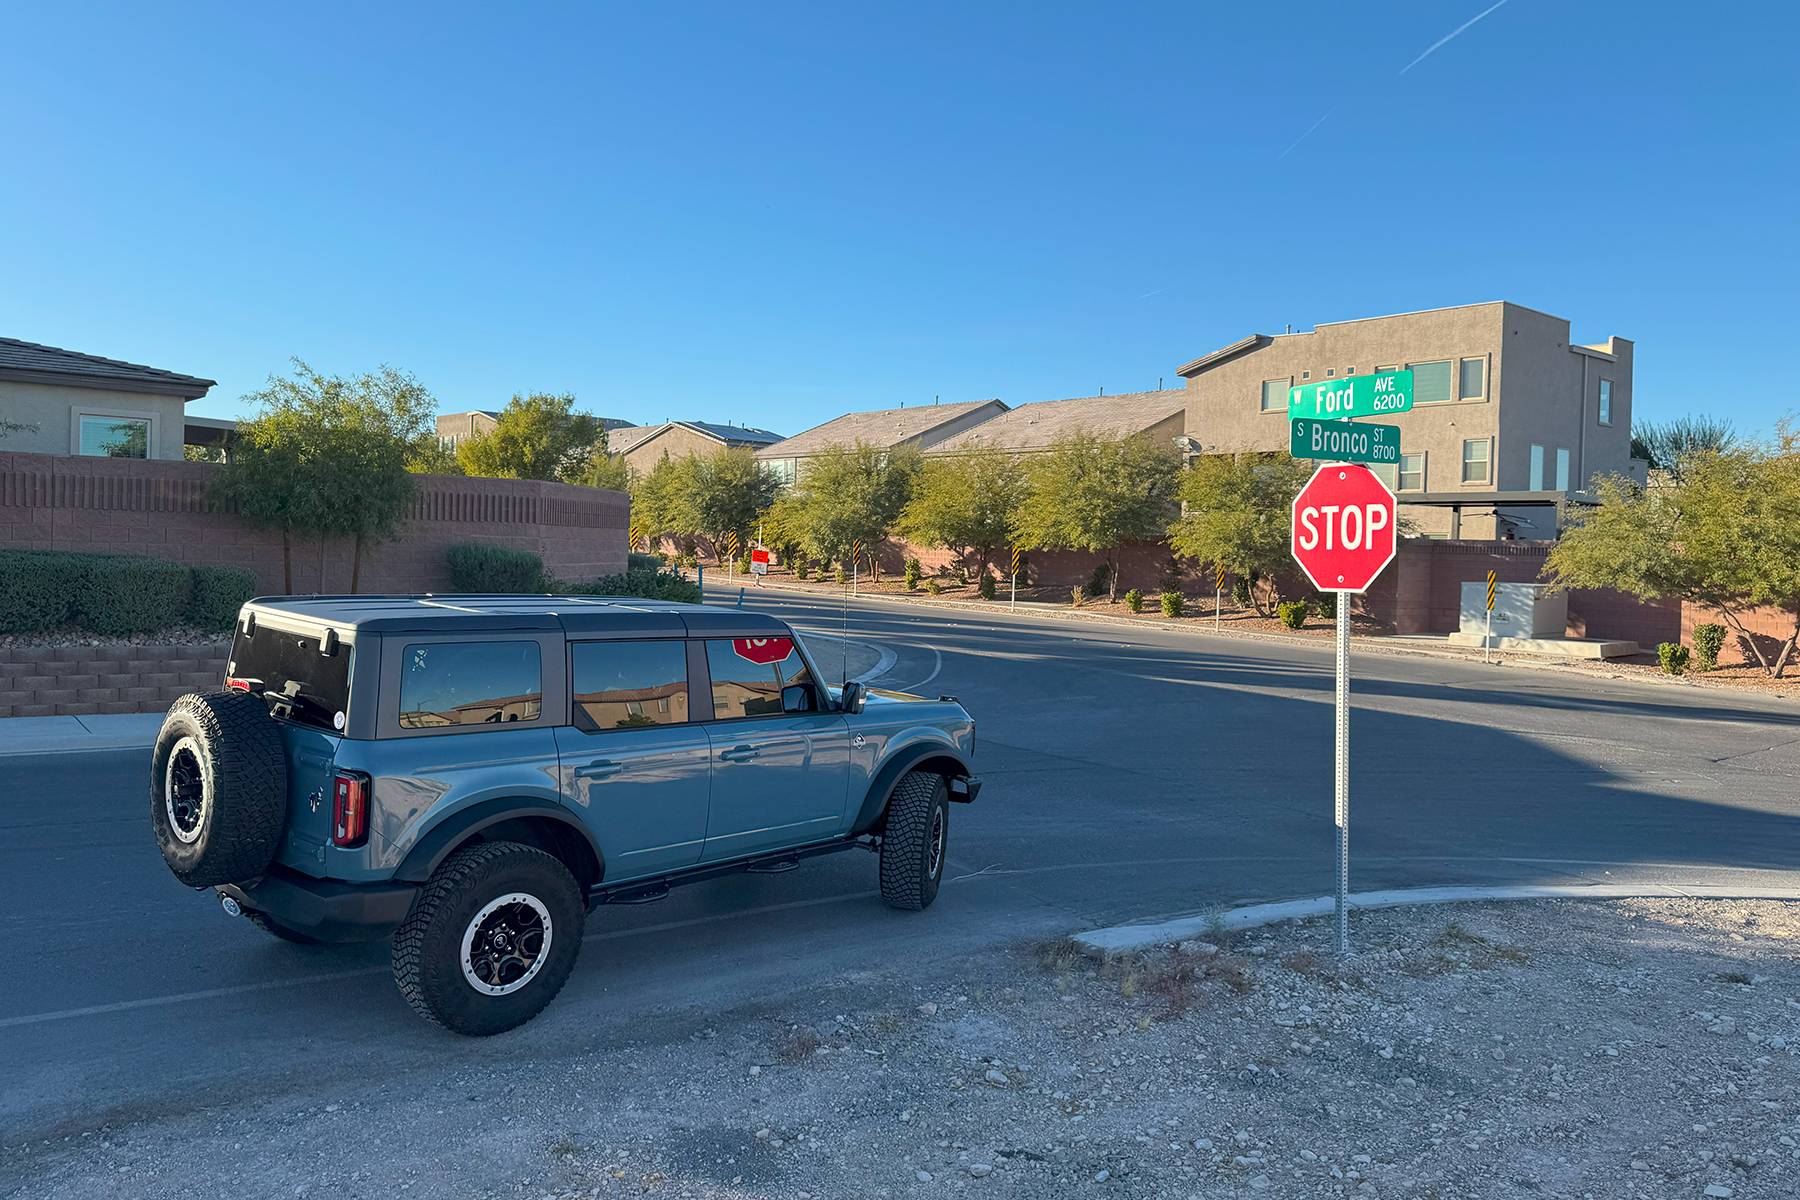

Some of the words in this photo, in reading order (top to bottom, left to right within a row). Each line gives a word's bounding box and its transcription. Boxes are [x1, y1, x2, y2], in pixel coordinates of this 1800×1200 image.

[1294, 389, 1302, 404] W
[1316, 382, 1354, 414] Ford
[1374, 376, 1395, 392] AVE
[1373, 393, 1405, 411] 6200
[1297, 422, 1304, 437] S
[1311, 423, 1368, 454] Bronco
[1373, 428, 1385, 442] ST
[1372, 445, 1396, 460] 8700
[1299, 503, 1388, 551] STOP
